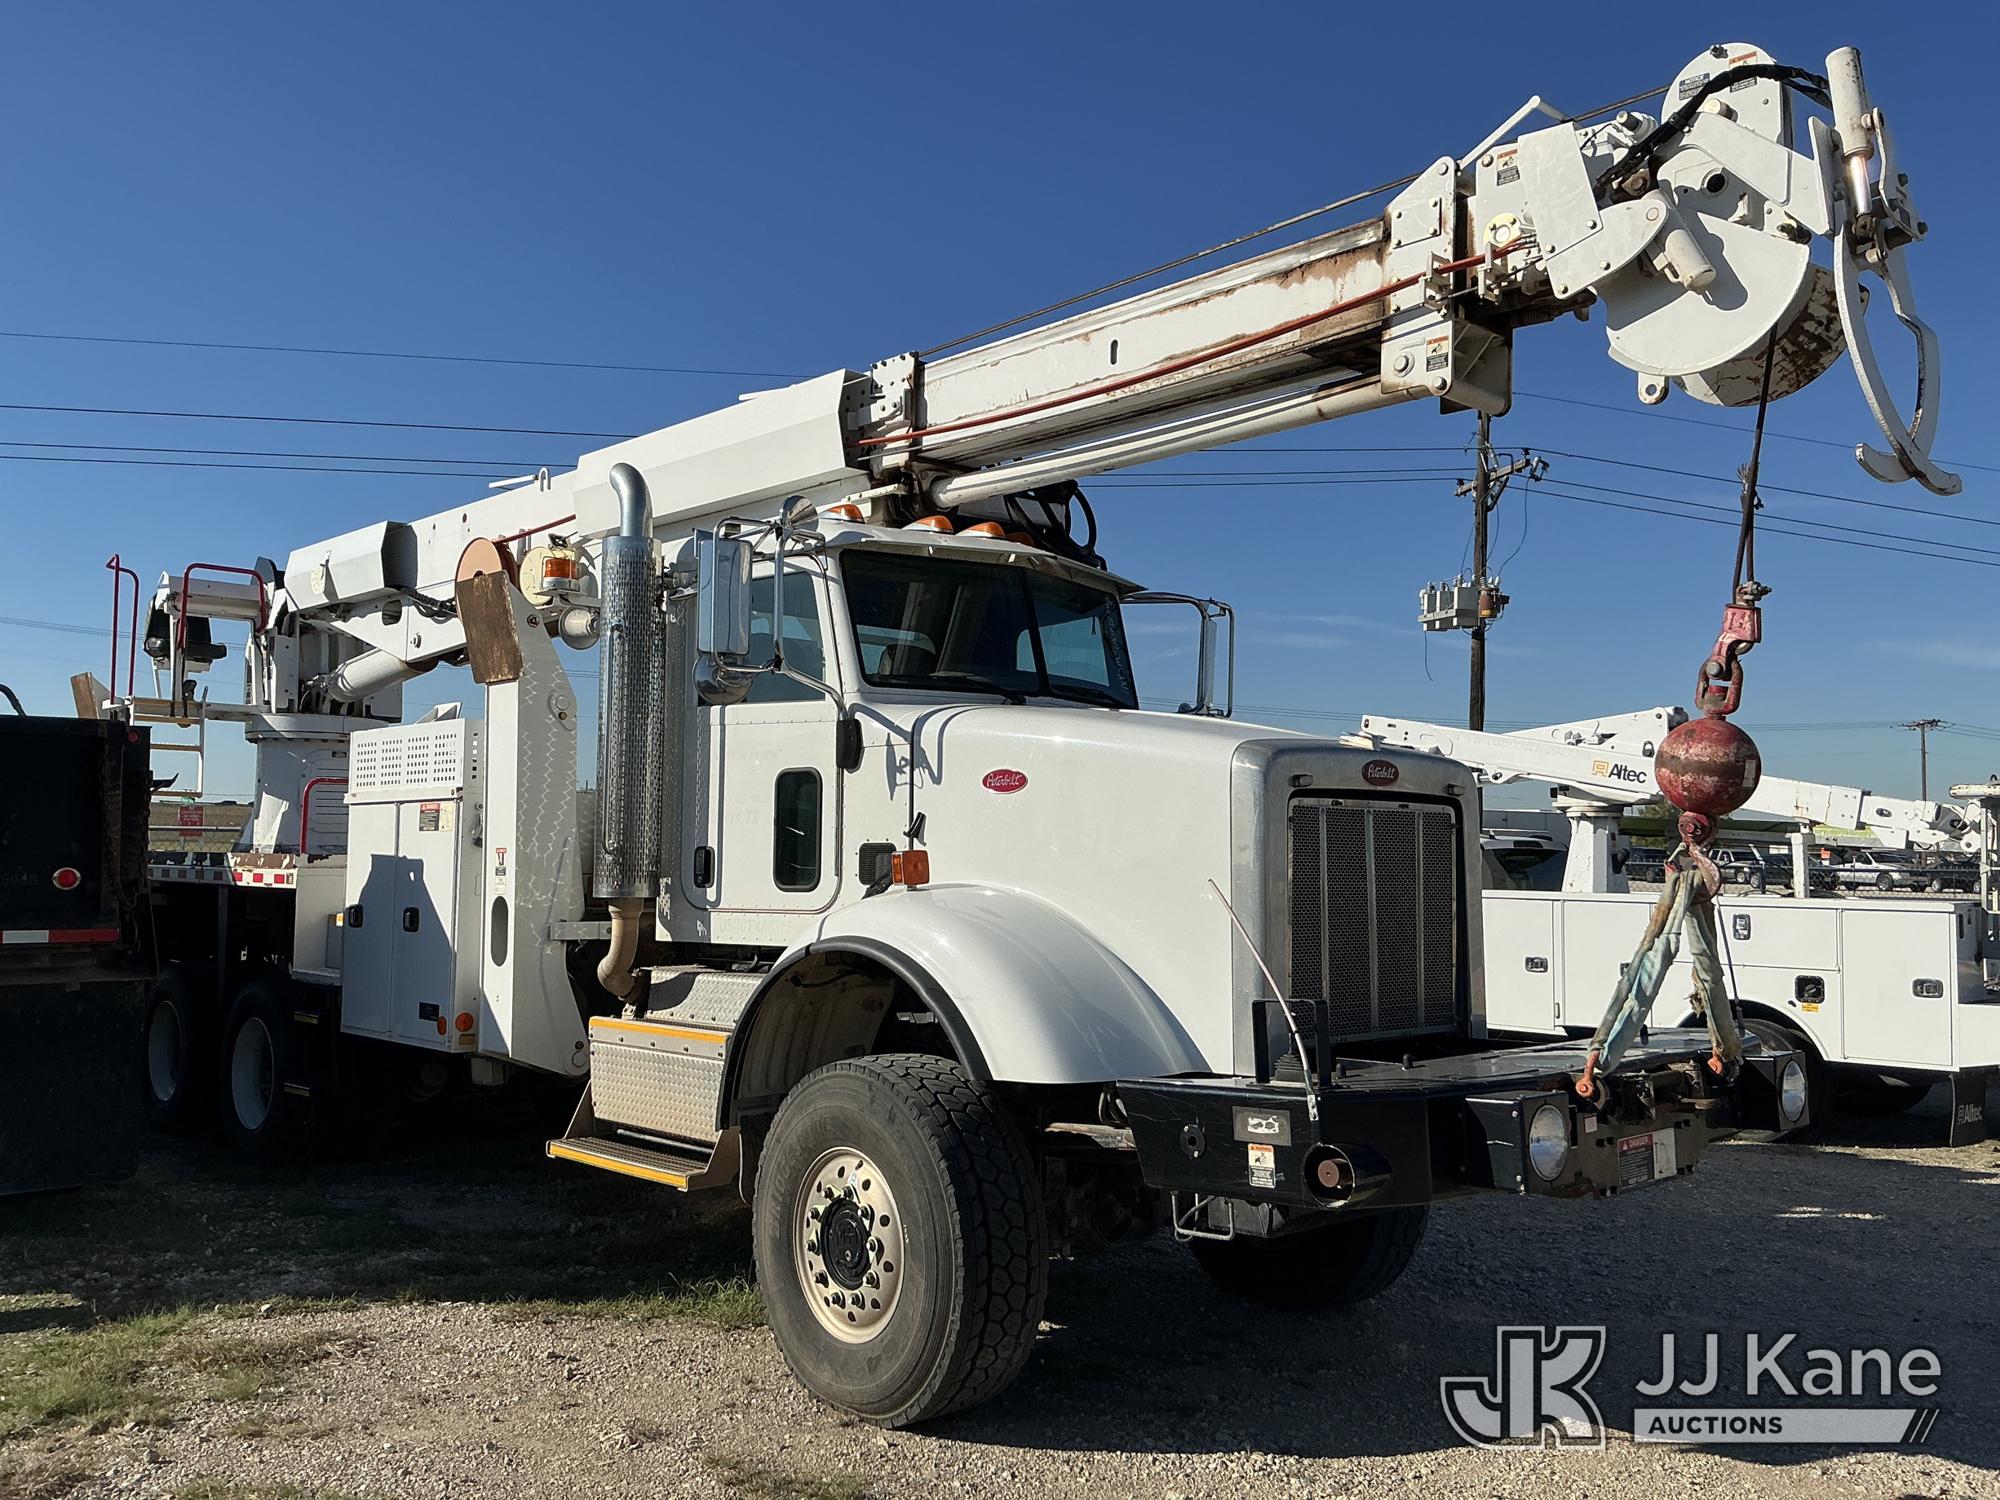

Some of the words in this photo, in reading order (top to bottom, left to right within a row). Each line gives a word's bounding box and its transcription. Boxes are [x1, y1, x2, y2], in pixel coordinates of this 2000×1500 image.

[1367, 764, 1396, 779] Peterbilt
[1608, 763, 1647, 783] Altec
[986, 773, 1023, 788] Peterbilt
